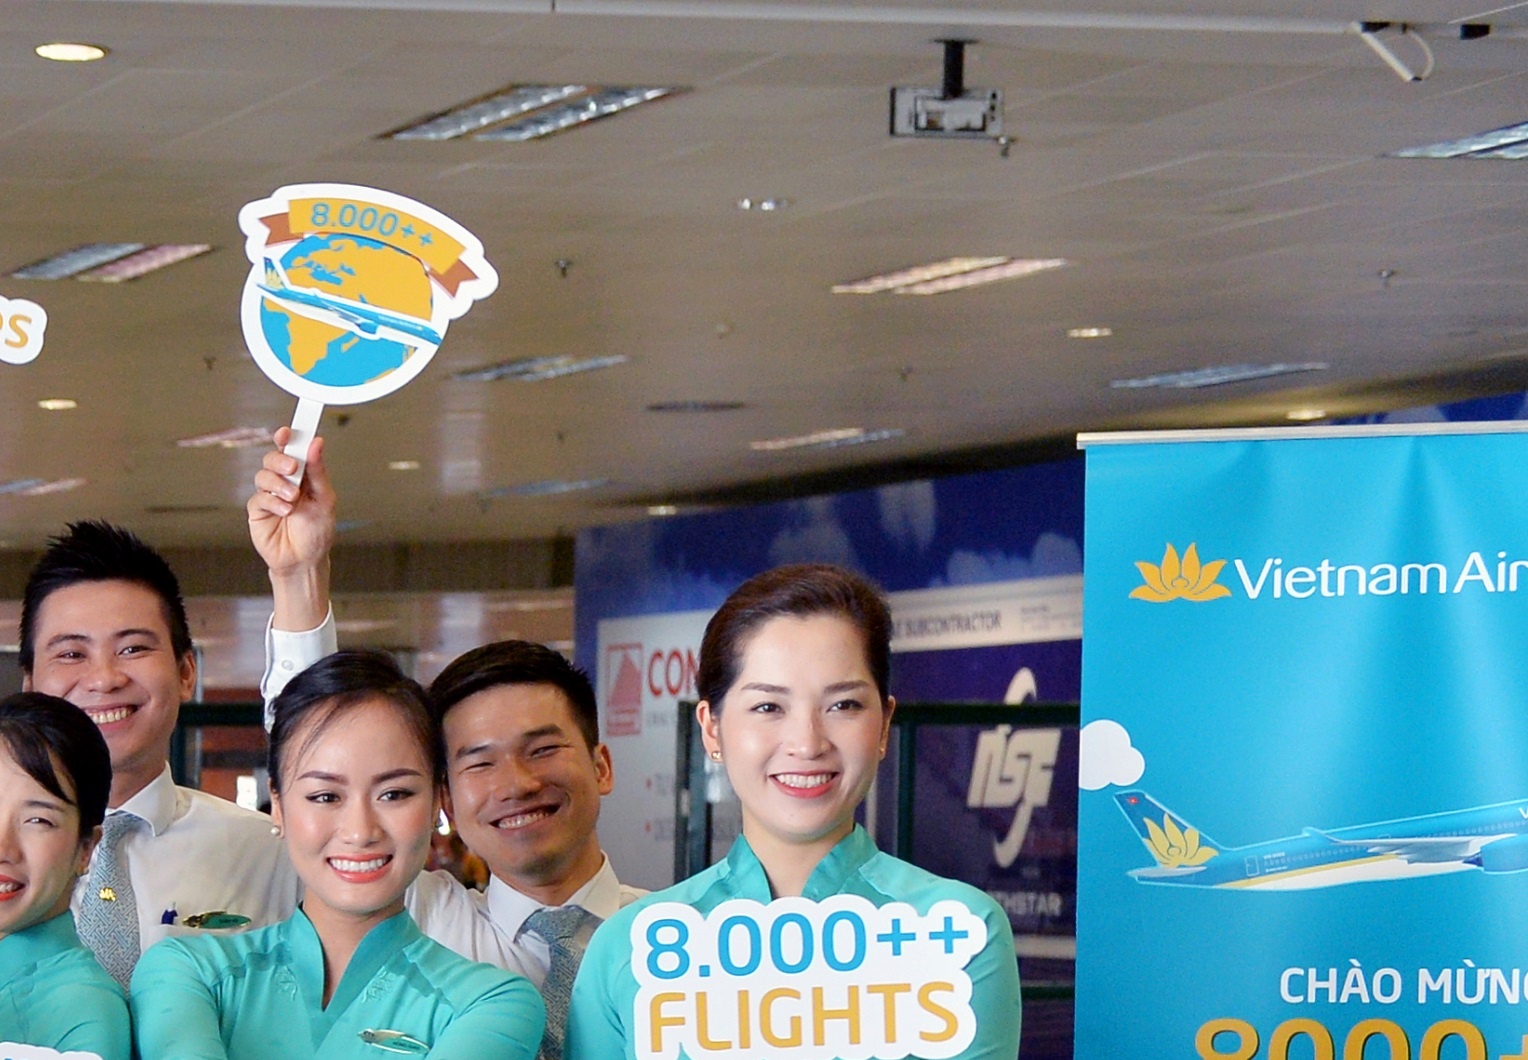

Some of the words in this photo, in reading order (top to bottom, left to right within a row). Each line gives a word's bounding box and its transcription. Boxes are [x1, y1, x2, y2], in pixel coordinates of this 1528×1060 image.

[311, 202, 433, 246] 8.000++
[1233, 556, 1446, 600] Vietnam
[1453, 551, 1528, 594] Air
[646, 910, 969, 980] 8.000++
[1280, 958, 1403, 1004] CHÀO
[1417, 958, 1528, 1005] MỪN
[650, 981, 960, 1054] FLIGHTS
